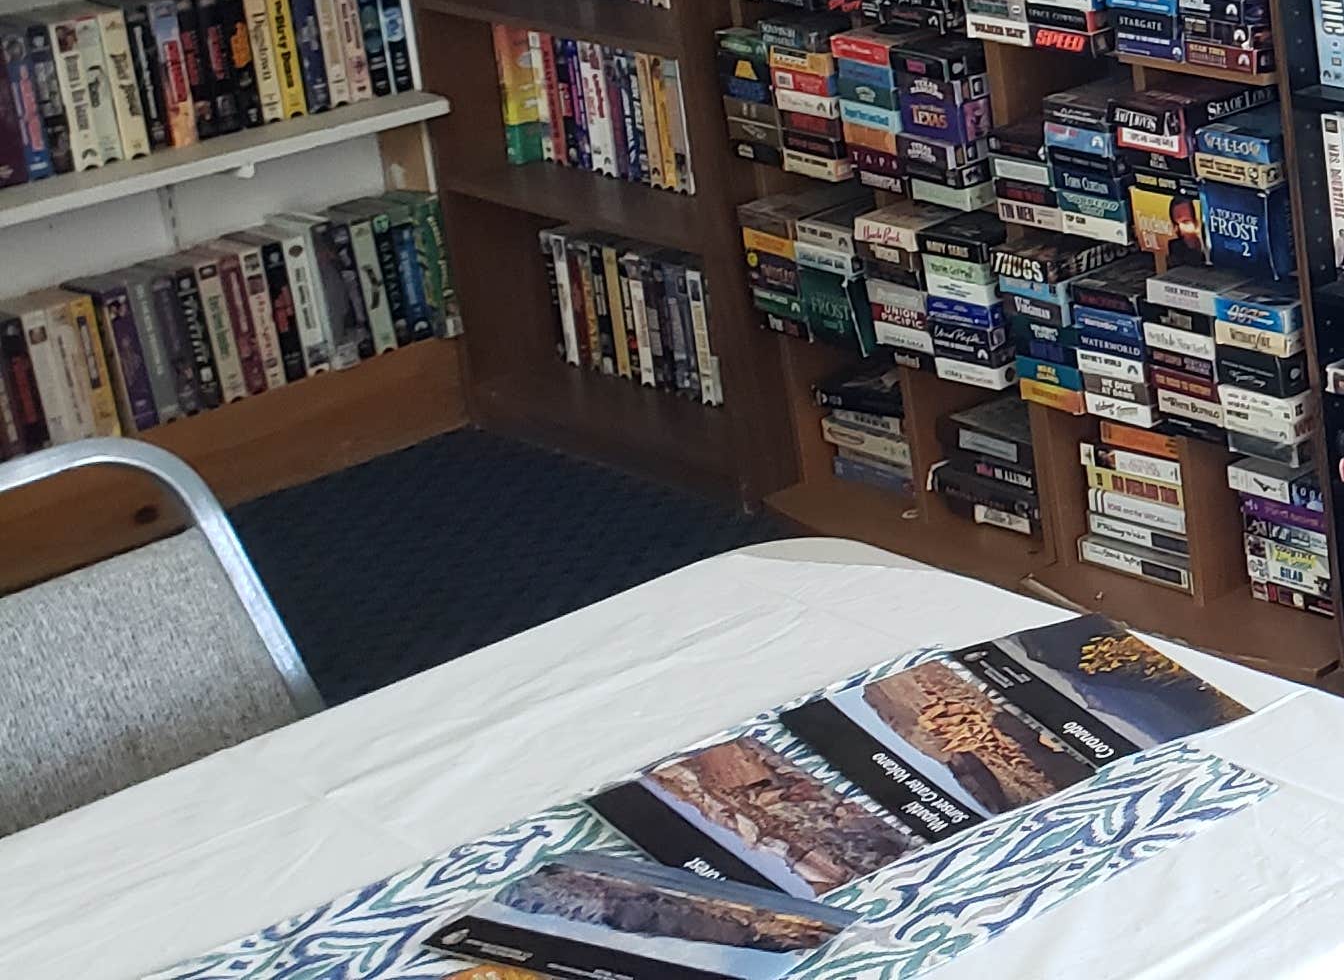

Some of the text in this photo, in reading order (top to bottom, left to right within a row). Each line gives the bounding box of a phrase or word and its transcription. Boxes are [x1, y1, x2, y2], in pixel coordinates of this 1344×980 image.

[1119, 17, 1162, 31] STARGATE
[1035, 29, 1085, 52] SPEED
[1210, 219, 1258, 242] FROST
[1242, 243, 1251, 257] 2
[994, 252, 1044, 283] THUGS
[881, 314, 924, 330] PACIFIC
[883, 304, 919, 321] UNION
[1080, 335, 1141, 356] WATERWORLD
[1063, 720, 1115, 760] Coronado
[870, 751, 970, 825] Sunset Crater Volcano
